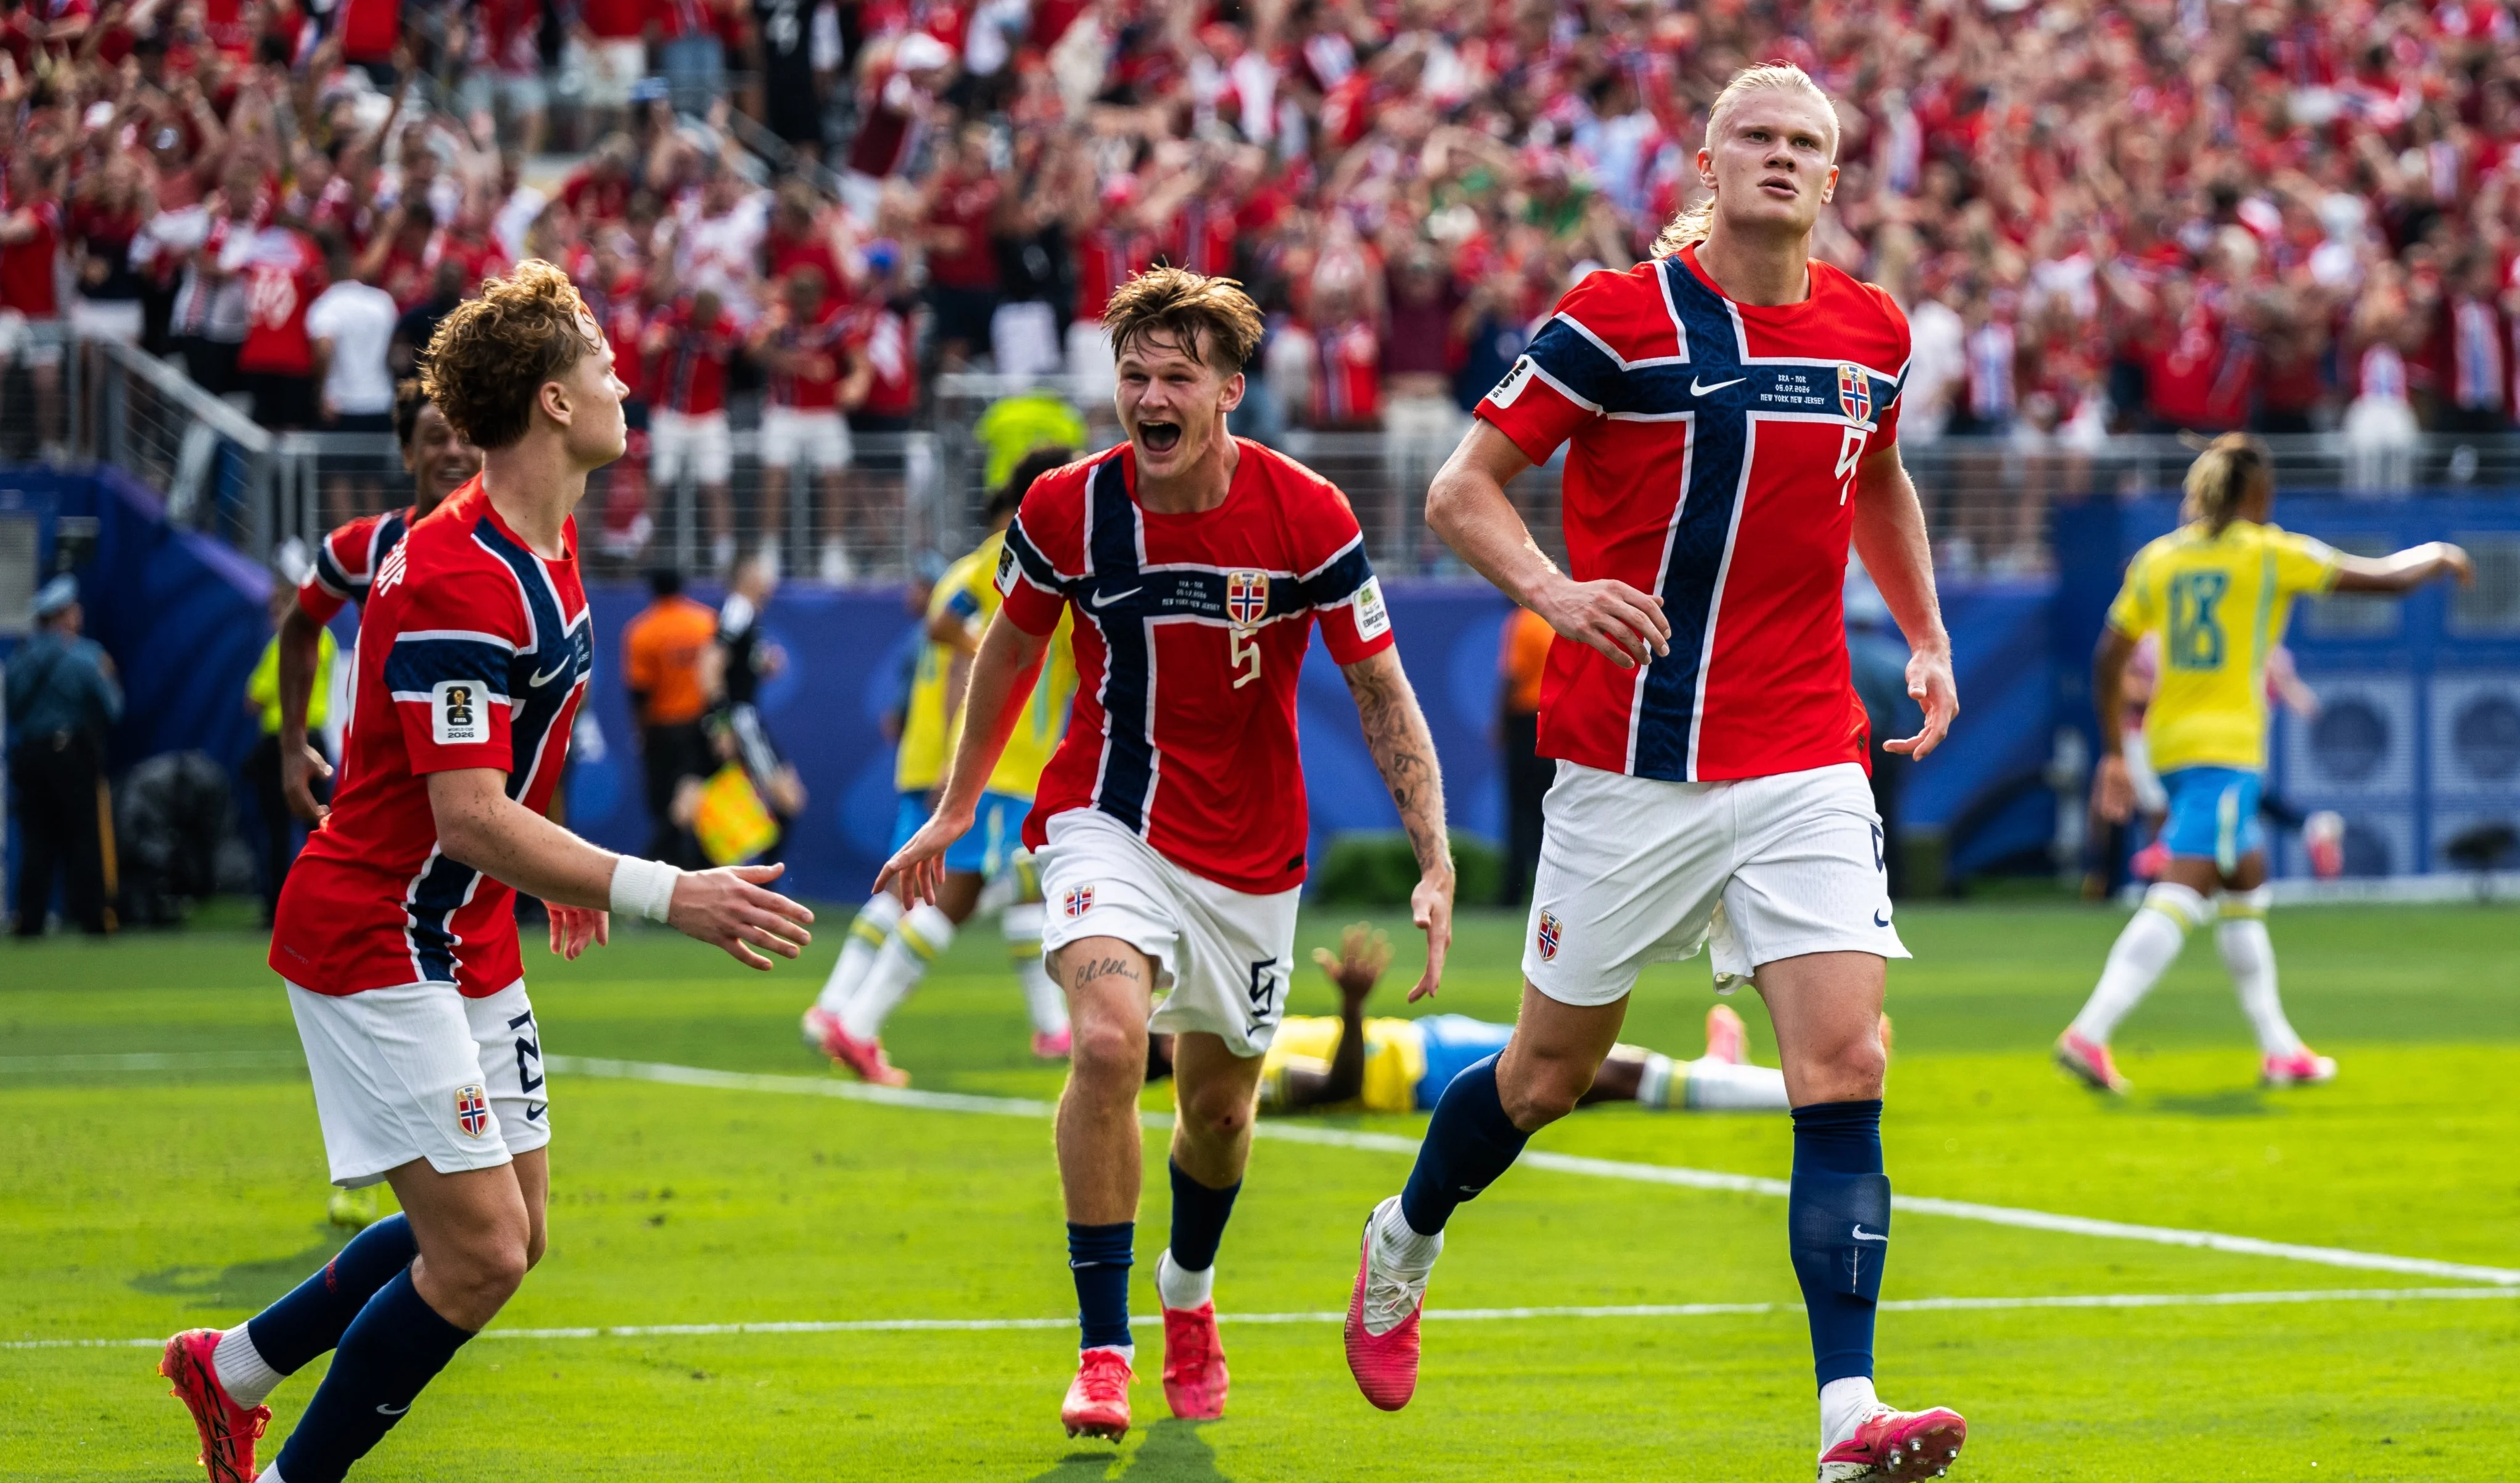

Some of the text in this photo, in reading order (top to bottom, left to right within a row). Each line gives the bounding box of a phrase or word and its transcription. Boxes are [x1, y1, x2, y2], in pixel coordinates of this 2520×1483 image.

[1760, 394, 1773, 402] NEW
[1774, 394, 1789, 402] YORK
[1803, 396, 1824, 404] JERSEY
[1775, 384, 1810, 393] 05.07.2026
[1778, 374, 1789, 382] BRA
[1795, 375, 1806, 383] NOR
[1834, 426, 1867, 506] 9
[2169, 571, 2228, 670] 18
[1229, 628, 1261, 689] 5
[1249, 956, 1277, 1017] 5
[508, 1009, 543, 1094] 2
